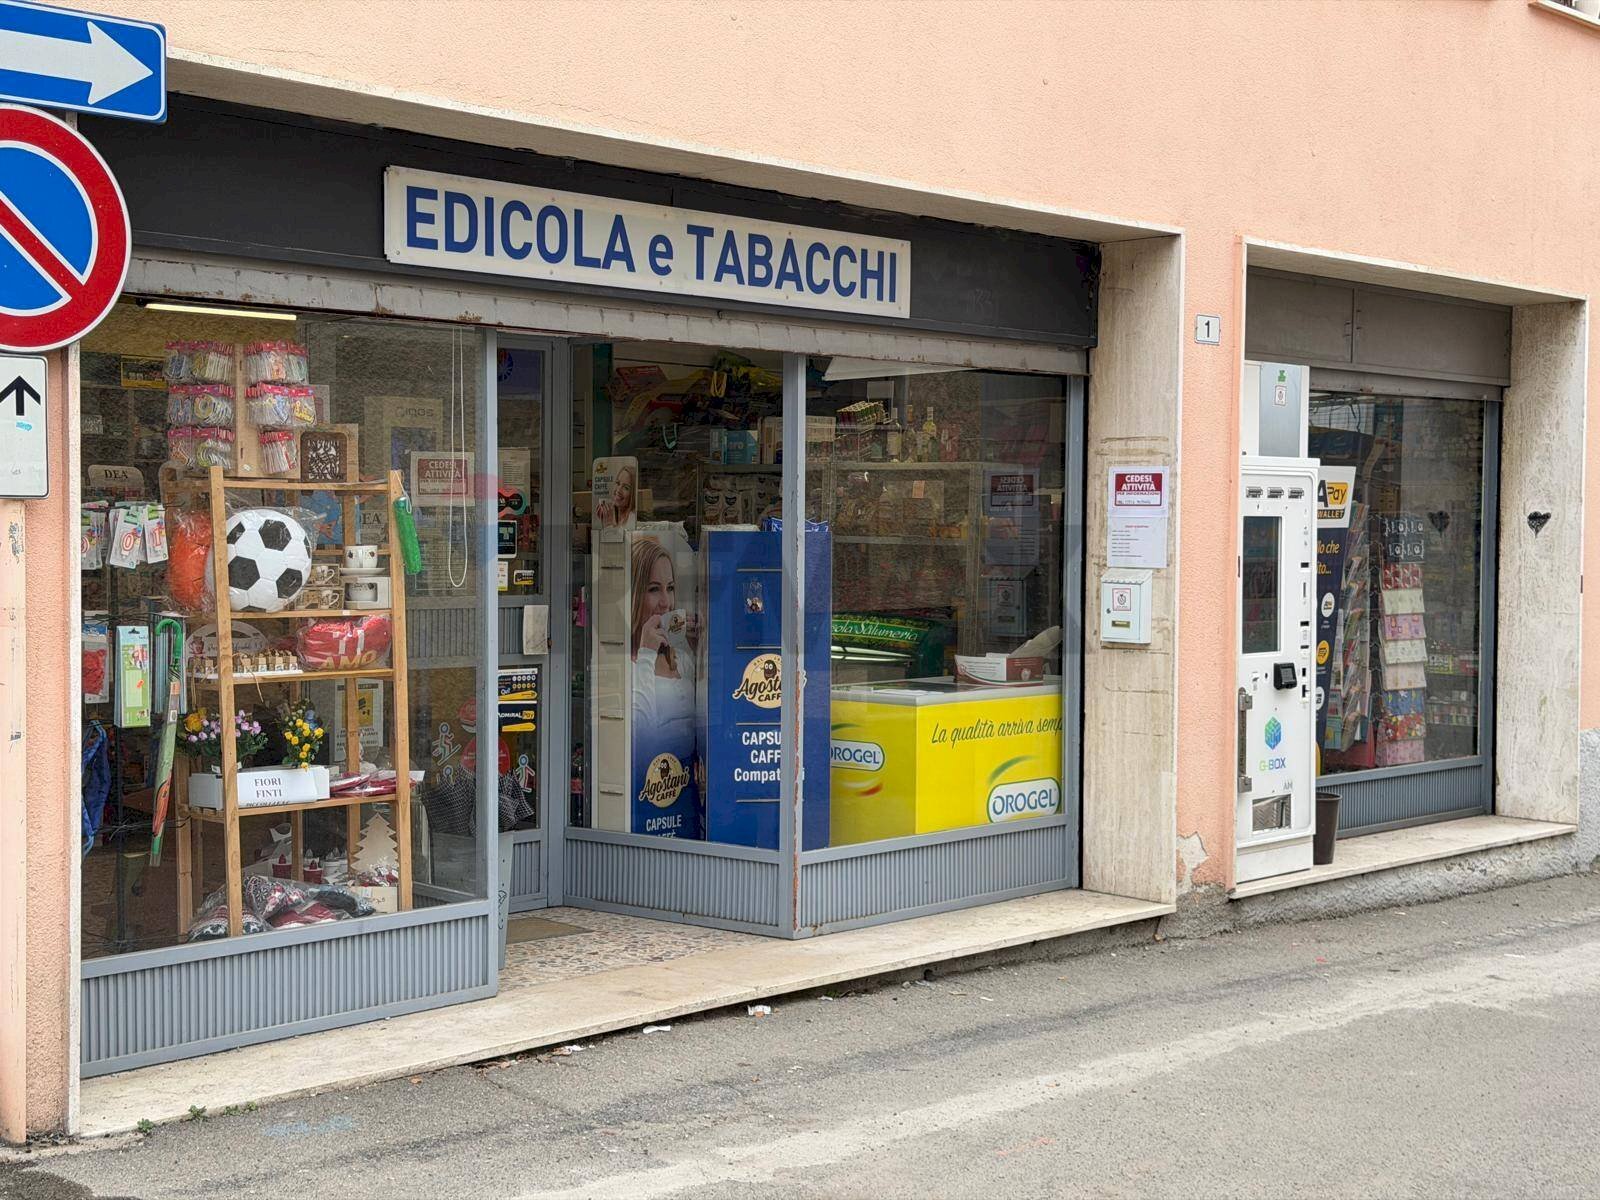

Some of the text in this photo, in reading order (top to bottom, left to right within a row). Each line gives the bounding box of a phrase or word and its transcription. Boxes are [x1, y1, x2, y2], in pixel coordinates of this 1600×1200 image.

[406, 185, 897, 303] EDICOLA e TABACCHI
[1204, 319, 1211, 338] 1
[103, 469, 129, 480] DEA
[1124, 474, 1153, 482] CEDESI
[1121, 480, 1156, 491] ATTIVITÀ
[360, 511, 382, 525] EA
[1325, 539, 1340, 555] che
[855, 619, 918, 641] Salumeria
[321, 649, 378, 670] AMO
[758, 692, 781, 702] CAFF
[742, 731, 781, 746] CAPSU
[931, 722, 948, 744] La
[950, 718, 995, 749] qualità
[997, 718, 1034, 737] arriva
[750, 749, 781, 764] CAFF
[254, 777, 282, 787] FIORI
[640, 766, 690, 801] Agostani
[255, 788, 283, 799] FINTI
[645, 814, 682, 832] CAPSULE
